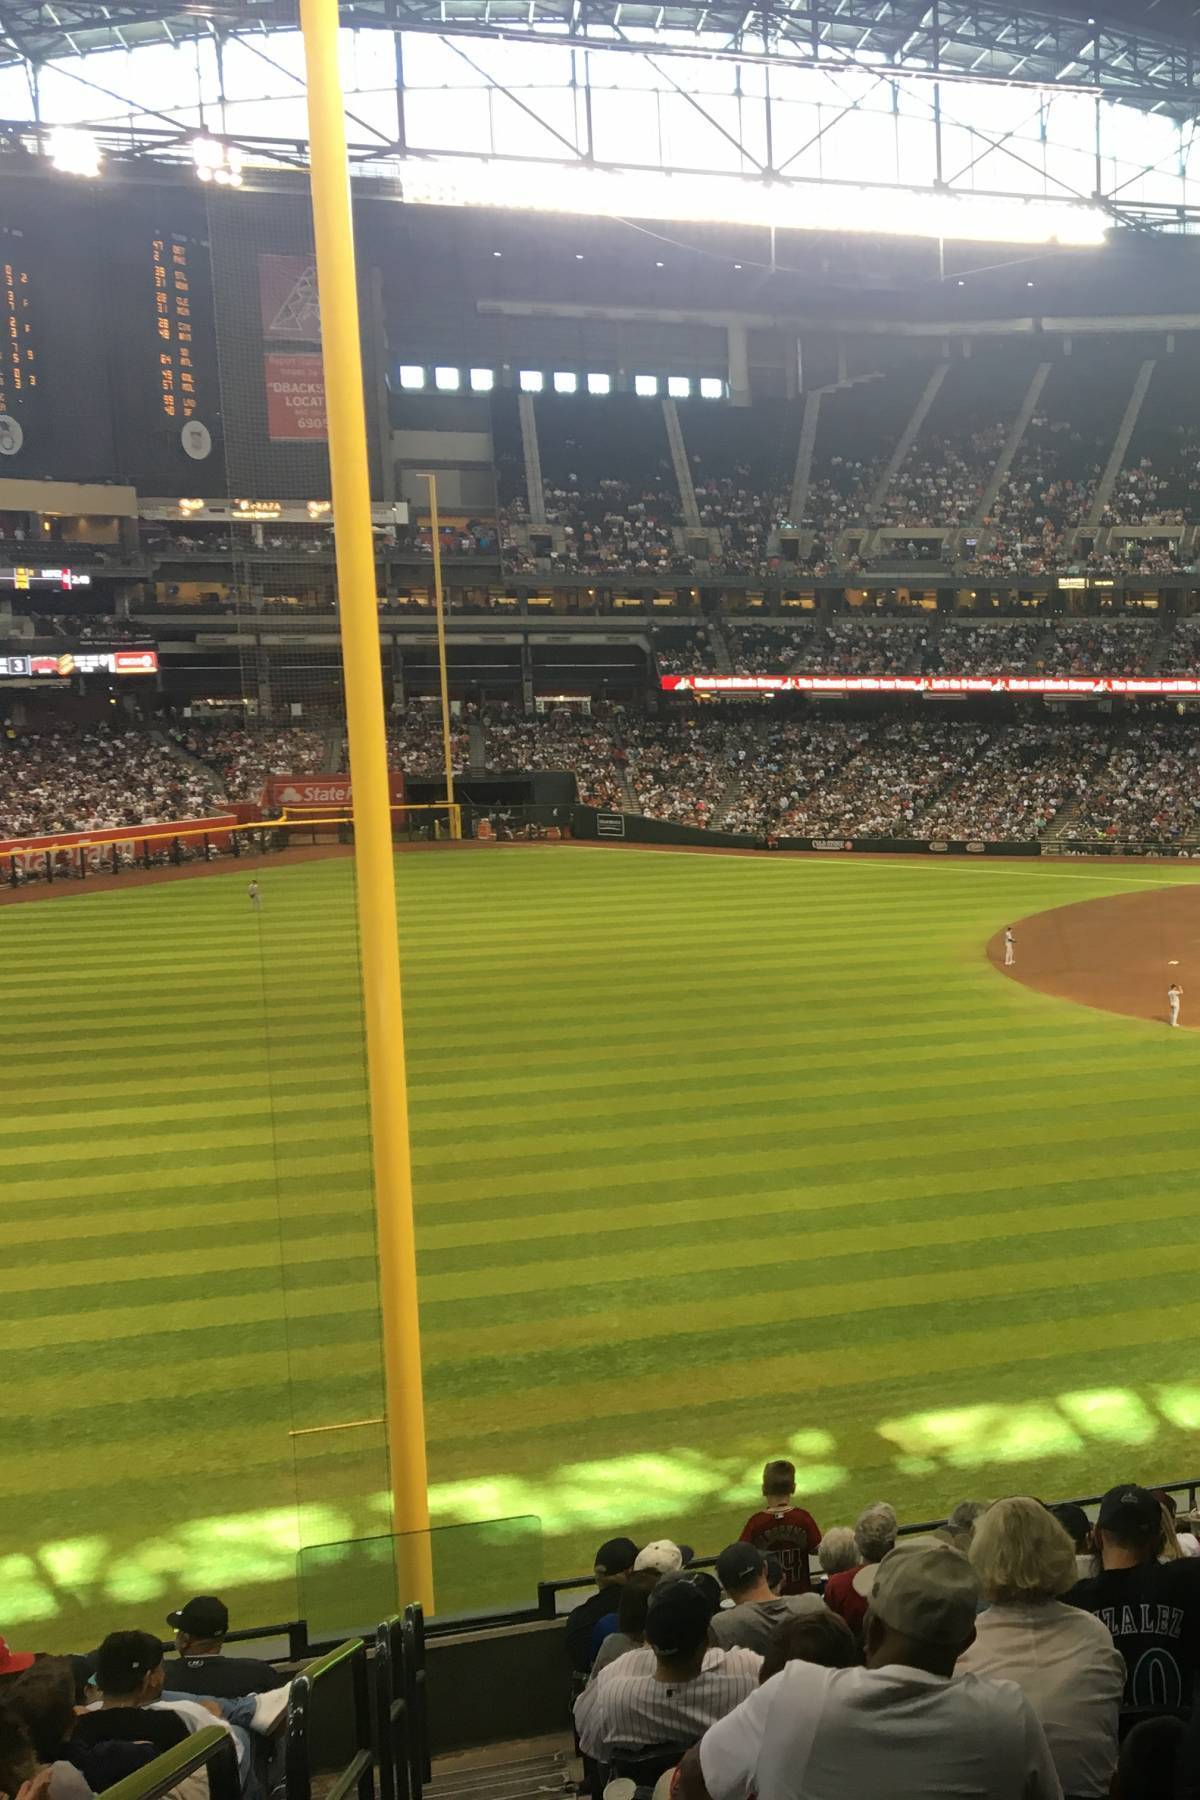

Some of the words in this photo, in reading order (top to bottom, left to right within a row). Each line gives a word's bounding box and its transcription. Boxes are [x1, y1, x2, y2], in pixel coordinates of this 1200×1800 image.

[285, 396, 325, 407] LOCAT
[13, 660, 23, 672] 3
[303, 786, 345, 801] State
[1094, 1603, 1184, 1640] ZALEZ
